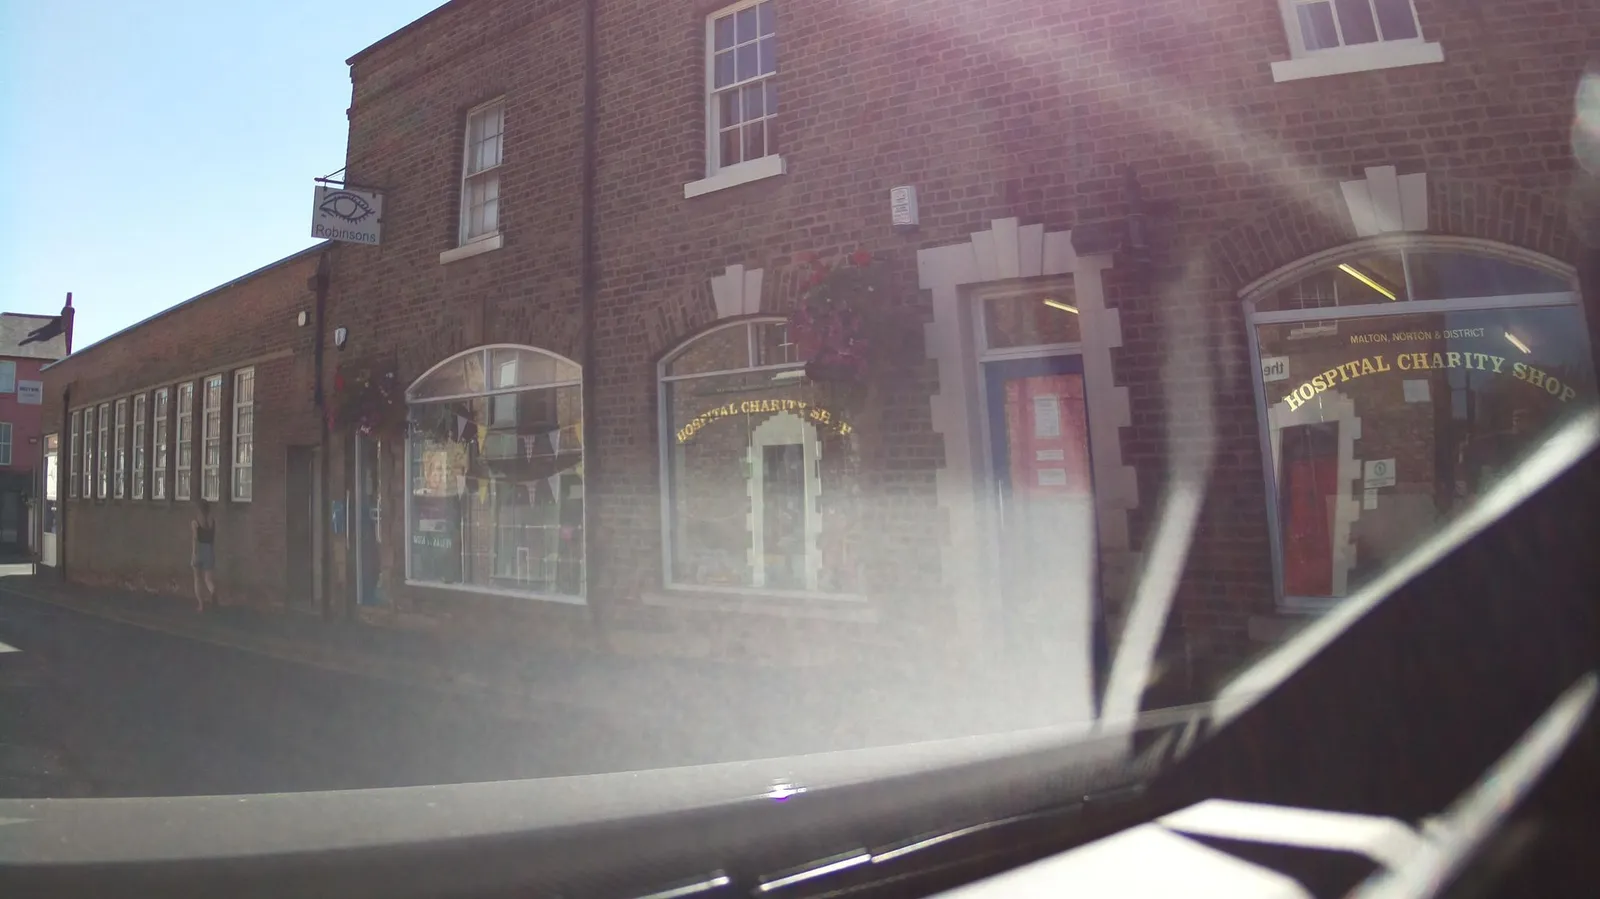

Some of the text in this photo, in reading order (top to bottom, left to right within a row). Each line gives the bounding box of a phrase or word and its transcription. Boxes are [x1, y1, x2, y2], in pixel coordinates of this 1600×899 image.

[315, 223, 376, 243] Robinsons
[1392, 331, 1432, 342] NORTON
[1434, 331, 1441, 340] &
[1443, 327, 1485, 339] DISTRICT
[1283, 351, 1576, 412] HOSPITAL CHARITY SHOP
[676, 403, 738, 443] HOSPITAL
[809, 406, 852, 436] SHP
